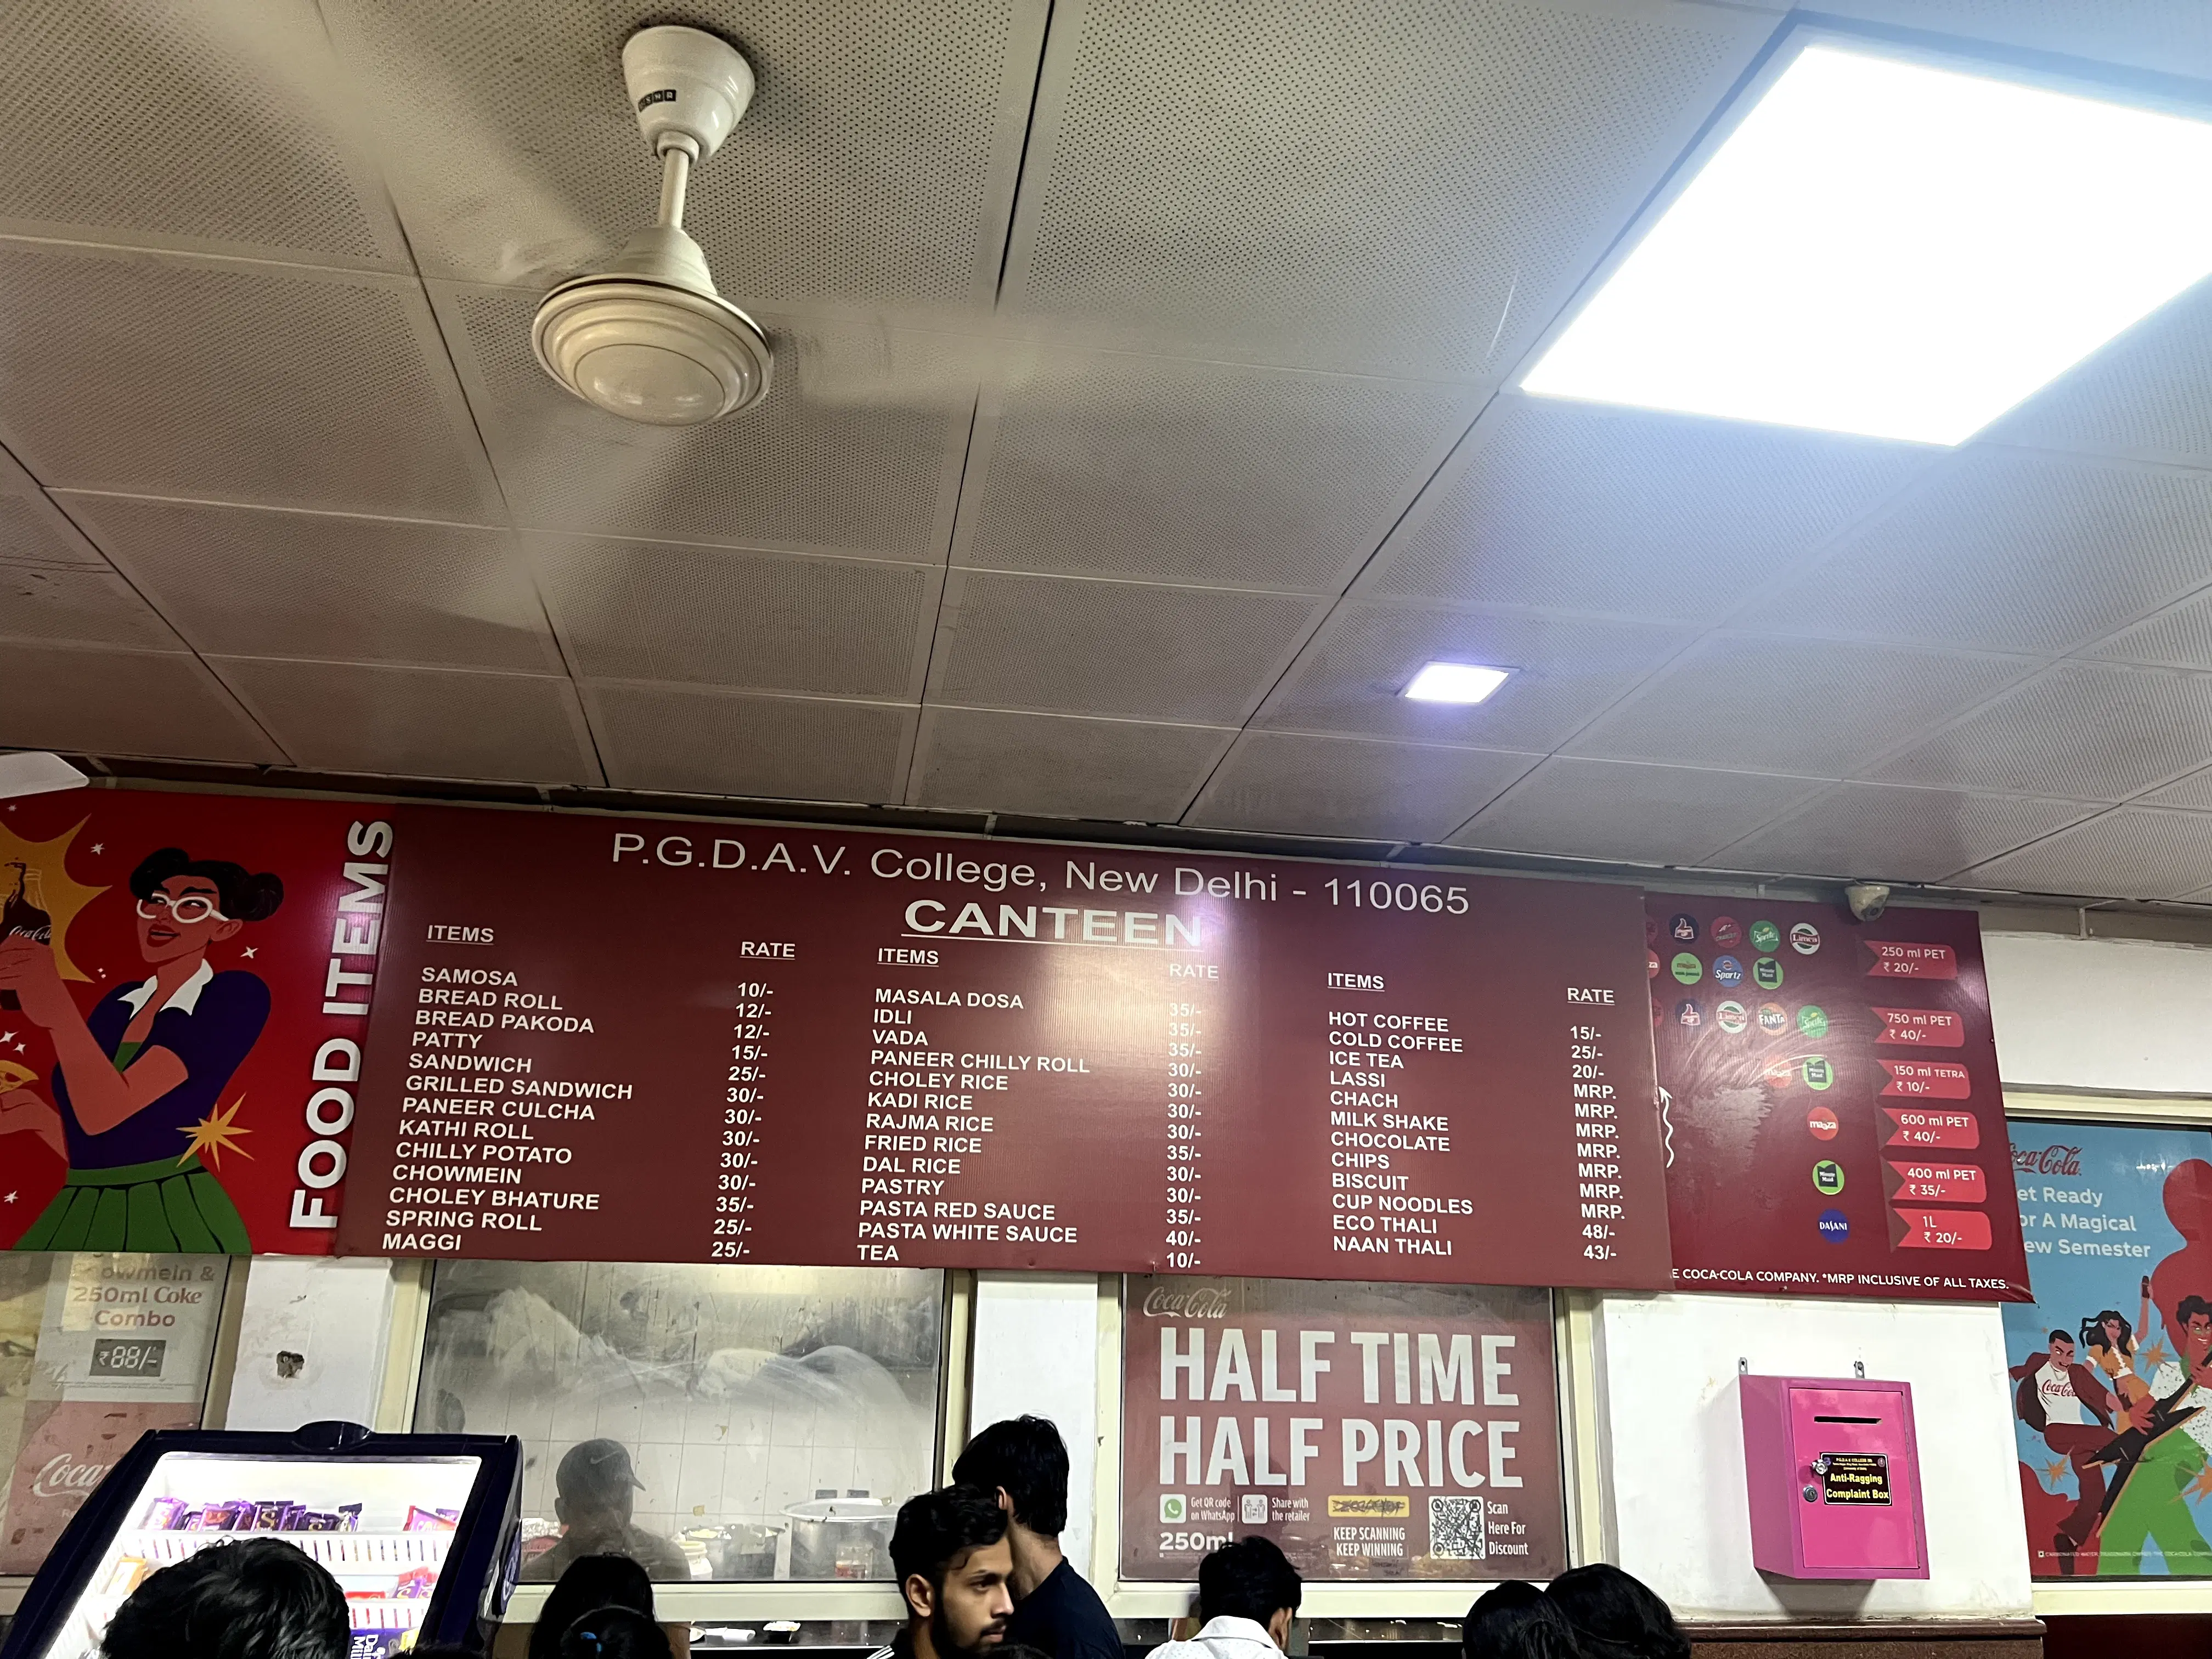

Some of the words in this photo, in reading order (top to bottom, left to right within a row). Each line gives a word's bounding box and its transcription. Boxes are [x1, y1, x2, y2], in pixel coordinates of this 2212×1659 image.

[613, 832, 851, 876] P.G.D.A.V.
[872, 849, 1046, 891] College,
[1066, 861, 1158, 893] New
[1173, 866, 1279, 902] Delhi
[1325, 879, 1468, 913] 110065
[323, 820, 394, 1015] ITEMS
[904, 900, 1203, 947] CANTEEN
[428, 926, 493, 942] ITEMS
[1793, 934, 1818, 943] Limca
[742, 942, 795, 957] RATE
[879, 949, 938, 964] ITEMS
[1882, 946, 1903, 956] 250
[1908, 949, 1920, 957] ml
[1925, 949, 1945, 958] PET
[422, 968, 517, 986] SAMOSA
[1894, 963, 1918, 974] 20/-
[738, 983, 773, 997] 10/-
[1329, 973, 1384, 990] ITEMS
[419, 989, 496, 1006] BREAD
[504, 993, 562, 1009] ROLL
[876, 989, 961, 1006] MASALA
[968, 993, 1023, 1008] DOSA
[1568, 988, 1614, 1005] RATE
[736, 1003, 771, 1018] 12/-
[874, 1009, 911, 1024] IDLI
[416, 1011, 494, 1027] BREAD
[502, 1014, 594, 1032] PAKODA
[1329, 1012, 1368, 1026] HOT
[1374, 1015, 1448, 1031] COFFEE
[413, 1032, 482, 1048] PATTY
[873, 1030, 928, 1045] VADA
[1330, 1031, 1381, 1047] COLD
[1388, 1035, 1462, 1052] COFFEE
[732, 1045, 767, 1060] 15/-
[1330, 1051, 1360, 1065] ICE
[1366, 1053, 1403, 1068] TEA
[1572, 1045, 1602, 1059] 25/-
[409, 1053, 531, 1073] SANDWICH
[872, 1050, 953, 1067] PANEER
[961, 1054, 1030, 1070] CHILLY
[1037, 1057, 1090, 1072] ROLL
[1169, 1063, 1201, 1077] 30/-
[1894, 1065, 1914, 1075] 150
[1917, 1067, 1931, 1076] ml
[1934, 1069, 1965, 1078] TETRA
[407, 1075, 504, 1093] GRILLED
[511, 1080, 632, 1099] SANDWICH
[870, 1071, 955, 1088] CHOLEY
[961, 1074, 1008, 1090] RICE
[1331, 1071, 1384, 1087] LASSI
[1907, 1082, 1929, 1093] 10/-
[1331, 1091, 1397, 1108] CHACH
[1574, 1084, 1616, 1099] MRP.
[403, 1098, 494, 1115] PANEER
[503, 1102, 594, 1120] CULCHA
[868, 1092, 917, 1108] KADI
[925, 1094, 972, 1109] RICE
[867, 1114, 939, 1130] RAJMA
[946, 1116, 992, 1131] RICE
[1331, 1111, 1376, 1127] MILK
[1384, 1114, 1448, 1131] SHAKE
[1901, 1114, 1925, 1125] 600
[1929, 1116, 1943, 1126] ml
[1946, 1116, 1968, 1127] PET
[290, 1037, 362, 1229] FOOD
[400, 1120, 466, 1136] KATHI
[474, 1122, 533, 1139] ROLL
[1914, 1131, 1940, 1143] 40/-
[865, 1135, 926, 1151] FRIED
[934, 1137, 981, 1153] RICE
[1331, 1132, 1449, 1151] CHOCOLATE
[397, 1142, 476, 1159] CHILLY
[483, 1145, 571, 1163] POTATO
[1332, 1152, 1389, 1169] CHIPS
[864, 1156, 905, 1172] DAL
[912, 1158, 960, 1173] RICE
[393, 1165, 521, 1183] CHOWMEIN
[1333, 1173, 1408, 1190] BISCUIT
[862, 1178, 944, 1195] PASTRY
[390, 1187, 485, 1205] CHOLEY
[492, 1190, 599, 1209] BHATURE
[716, 1197, 753, 1212] 35/-
[1333, 1194, 1372, 1209] CUP
[1379, 1196, 1472, 1214] NOODLES
[2018, 1187, 2037, 1202] et
[2043, 1187, 2103, 1207] Ready
[861, 1200, 927, 1216] PASTA
[934, 1203, 977, 1217] RED
[984, 1203, 1054, 1220] SAUCE
[386, 1210, 473, 1227] SPRING
[482, 1213, 541, 1231] ROLL
[1334, 1215, 1374, 1231] ECO
[1380, 1217, 1436, 1233] THALI
[1819, 1221, 1847, 1231] DASANI
[1923, 1216, 1937, 1227] 1L
[2021, 1214, 2036, 1227] or
[2042, 1213, 2056, 1228] A
[2061, 1214, 2136, 1233] Magical
[859, 1222, 926, 1239] PASTA
[933, 1224, 998, 1240] WHITE
[1006, 1226, 1076, 1242] SAUCE
[1166, 1231, 1200, 1246] 40/-
[1583, 1224, 1615, 1239] 48/-
[1936, 1232, 1961, 1244] 20/-
[383, 1234, 461, 1250] MAGGI
[1334, 1236, 1388, 1252] NAAN
[1395, 1239, 1451, 1255] THALI
[2024, 1241, 2052, 1254] ew
[2058, 1239, 2151, 1257] Semester
[857, 1245, 898, 1260] TEA
[1167, 1252, 1200, 1268] 10/-
[1683, 1269, 1753, 1280] COCA-COLA
[1757, 1272, 1819, 1282] COMPANY.
[1858, 1275, 1921, 1285] INCLUSIVE
[1924, 1277, 1939, 1286] OF
[1944, 1278, 1966, 1287] ALL
[1968, 1278, 2008, 1289] TAXES.
[73, 1287, 147, 1304] 250ml
[154, 1286, 204, 1304] Coke
[94, 1310, 176, 1327] Combo
[110, 1346, 157, 1370] 88/-
[1161, 1328, 1334, 1402] HALF
[1351, 1332, 1519, 1405] TIME
[1160, 1417, 1323, 1485] HALF
[1342, 1419, 1522, 1487] PRICE
[1830, 1474, 1882, 1485] Anti-Ragging
[1826, 1488, 1870, 1500] Complaint
[1872, 1489, 1889, 1499] Box
[1191, 1497, 1203, 1508] Get
[1204, 1498, 1214, 1509] QR
[1215, 1497, 1231, 1508] code
[1272, 1498, 1291, 1508] Share
[1293, 1498, 1308, 1508] with
[1487, 1501, 1508, 1515] Scan
[1191, 1512, 1199, 1520] on
[1201, 1510, 1234, 1523] WhatsApp
[1272, 1510, 1283, 1521] the
[1285, 1510, 1310, 1521] retailer
[1334, 1527, 1357, 1541] KEEP
[1359, 1527, 1405, 1541] SCANNING
[1488, 1521, 1509, 1534] Here
[1511, 1522, 1526, 1534] For
[1336, 1543, 1361, 1556] KEEP
[1362, 1543, 1403, 1556] WINNING
[1489, 1542, 1528, 1555] Discount
